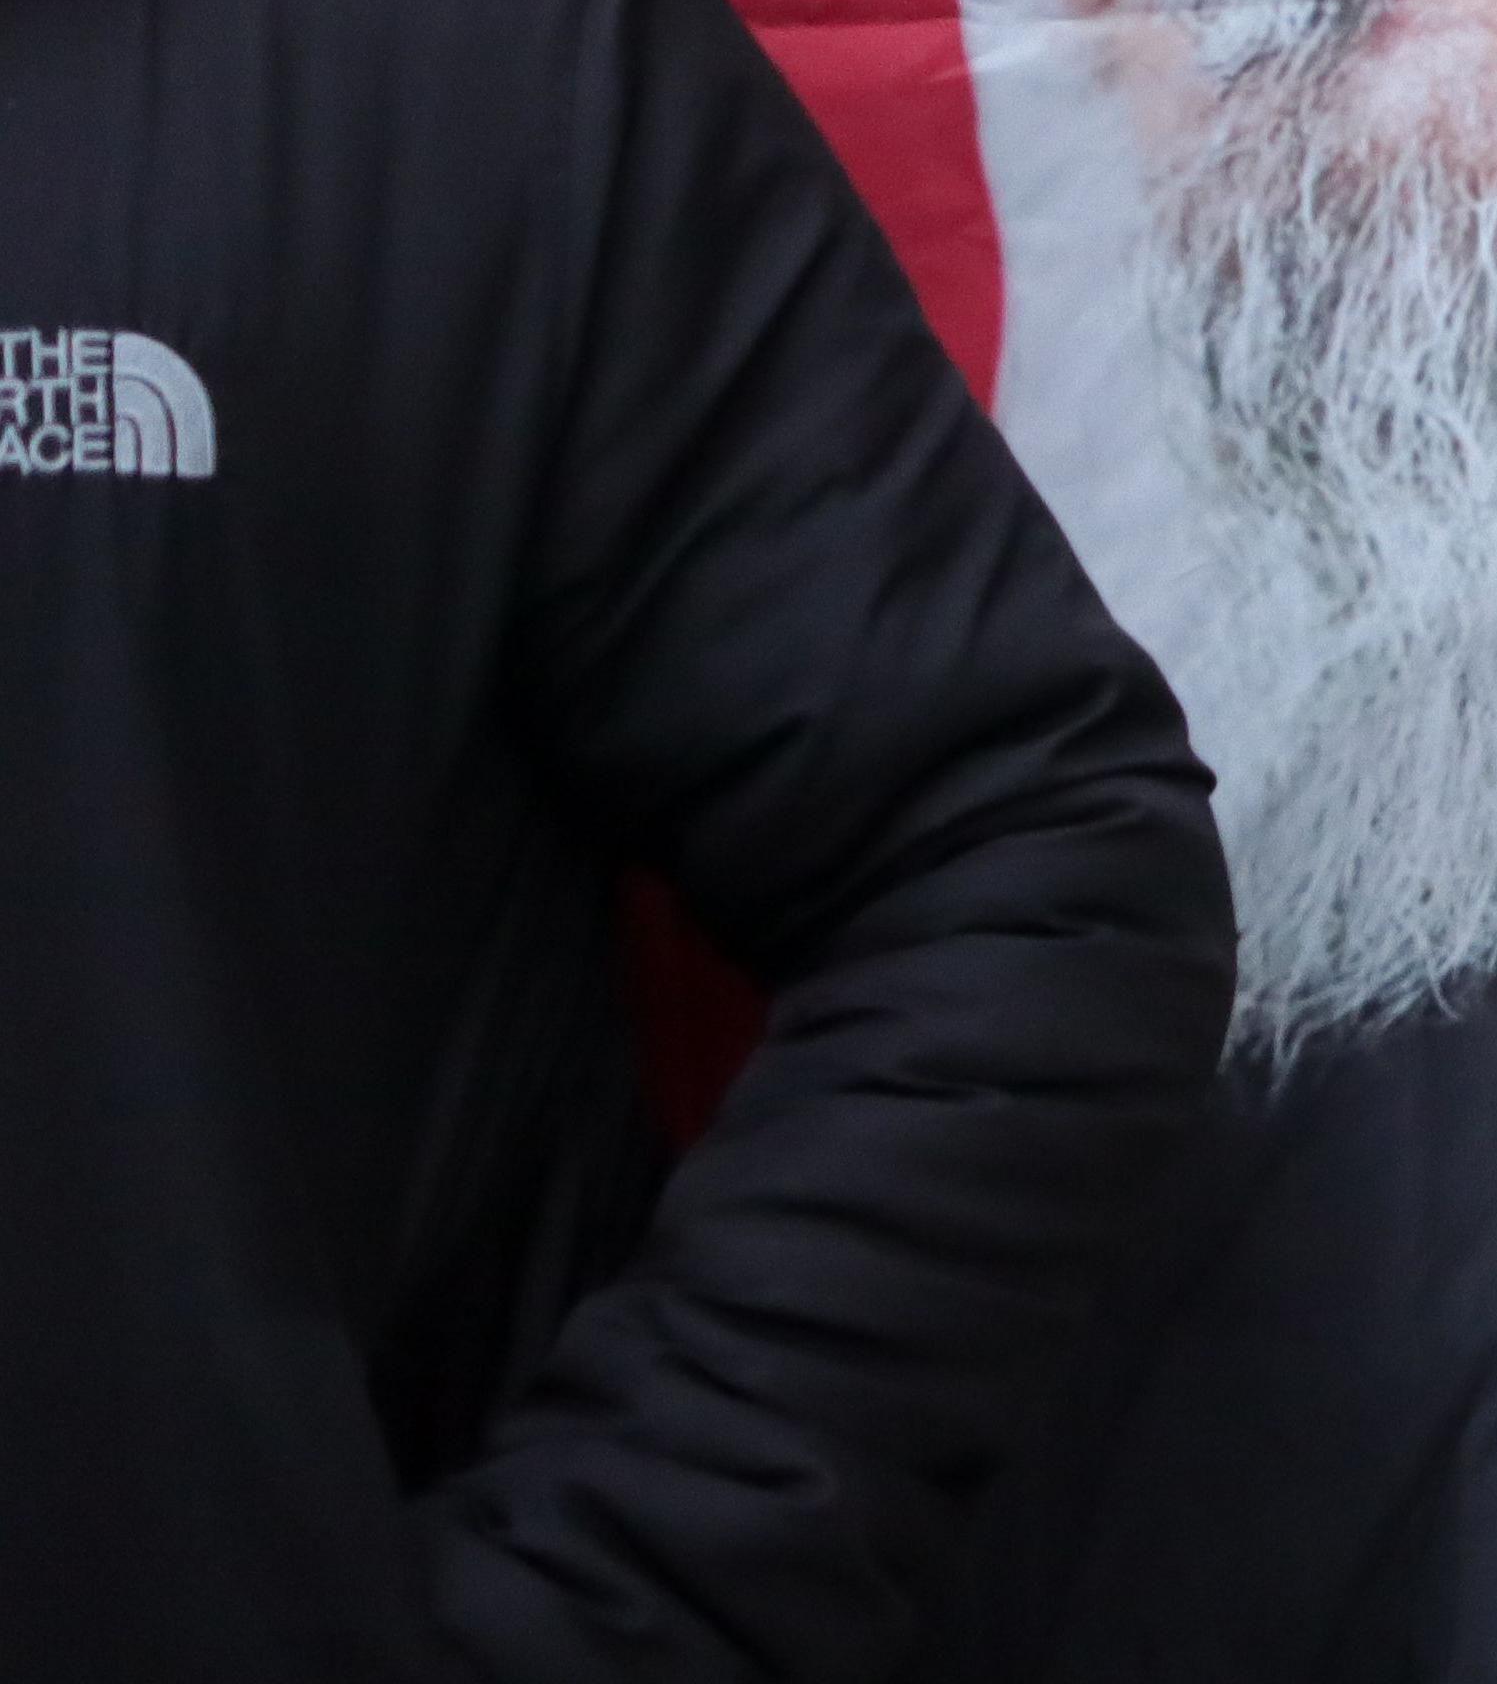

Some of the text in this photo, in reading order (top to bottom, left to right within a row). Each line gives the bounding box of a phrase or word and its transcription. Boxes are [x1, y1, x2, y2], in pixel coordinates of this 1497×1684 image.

[0, 327, 112, 377] THE
[0, 377, 110, 428] RTH
[0, 422, 112, 477] ACE
